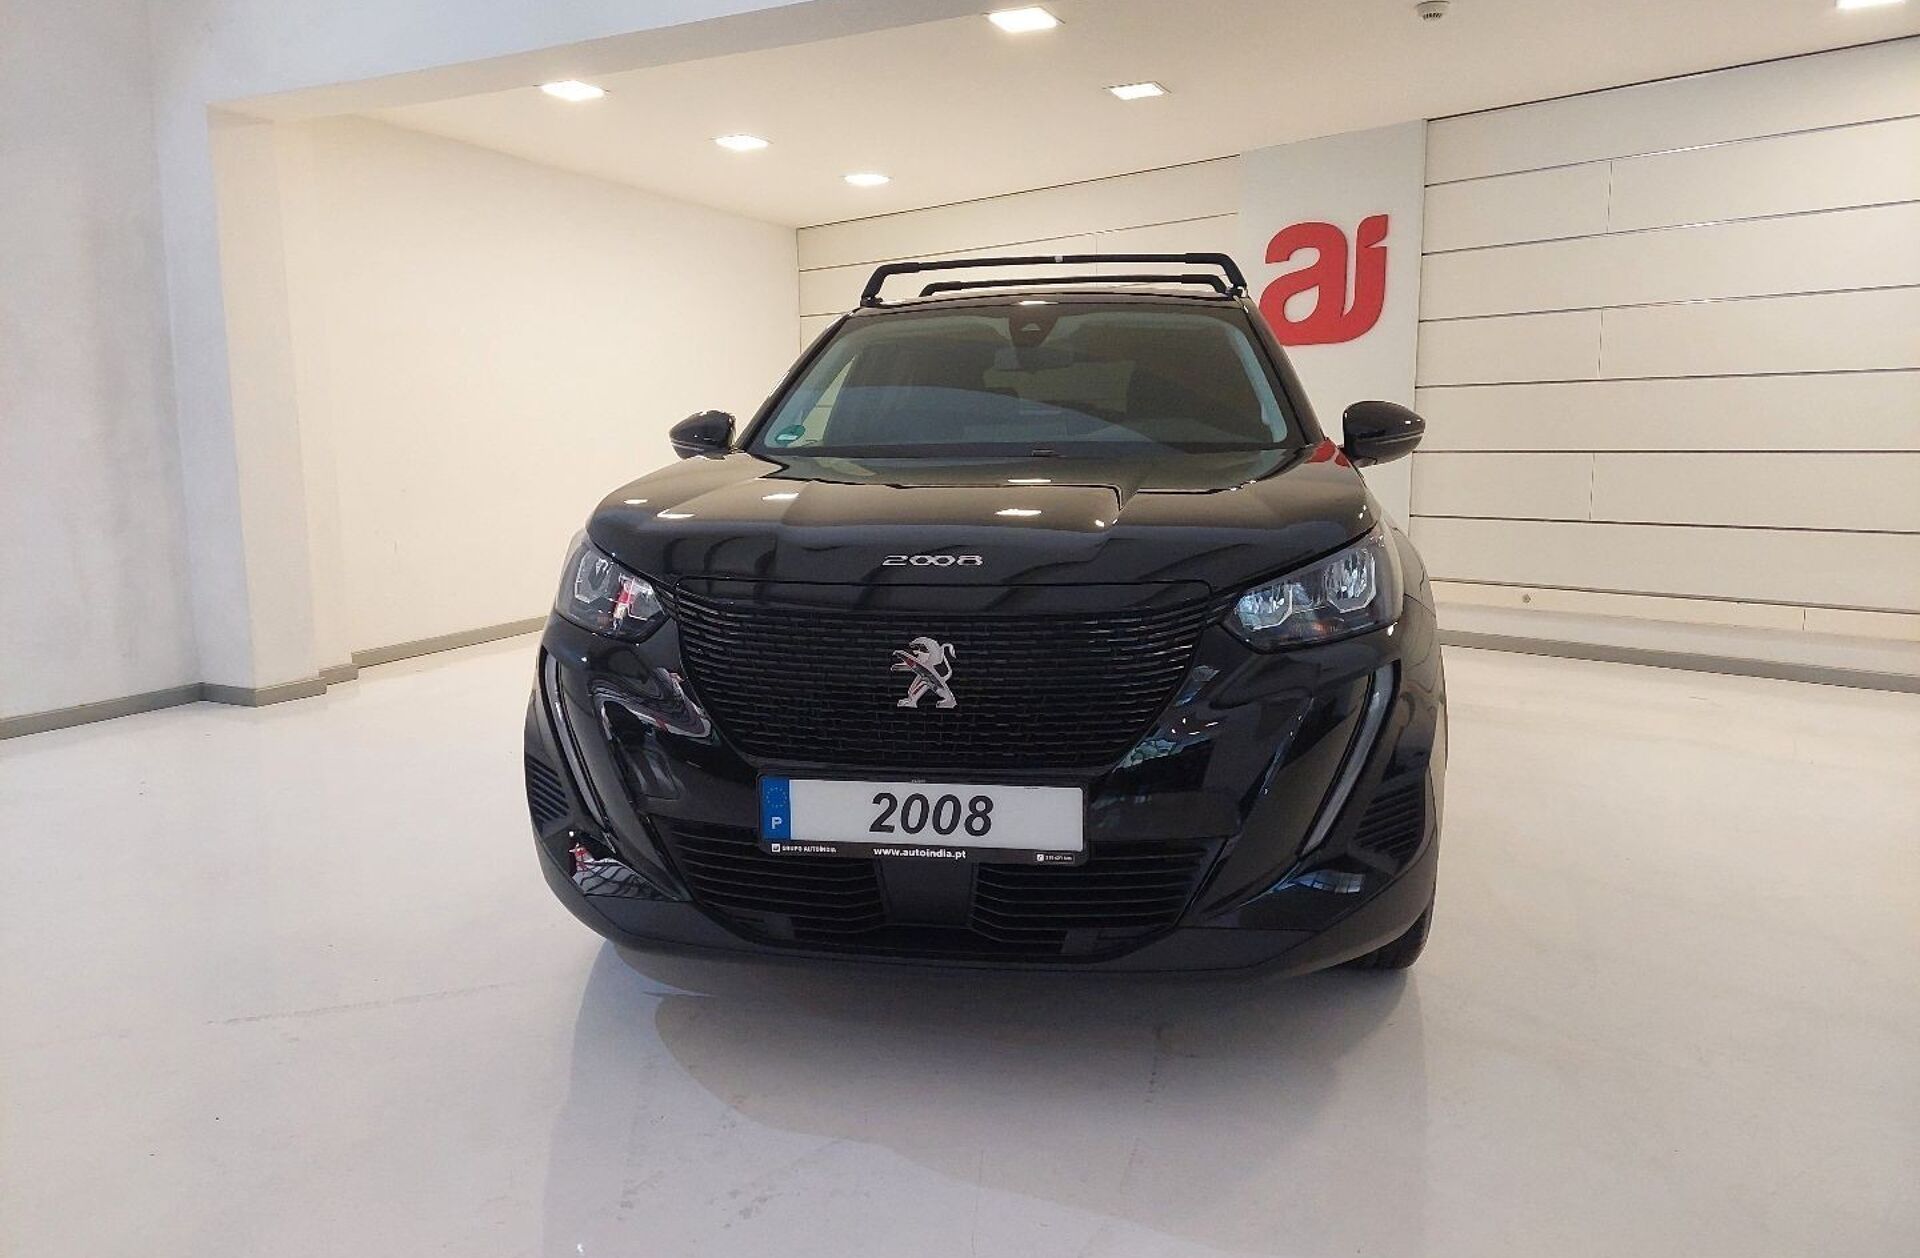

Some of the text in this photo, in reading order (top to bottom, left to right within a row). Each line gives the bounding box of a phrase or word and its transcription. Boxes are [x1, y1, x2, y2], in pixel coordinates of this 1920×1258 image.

[882, 555, 984, 567] 2008
[869, 792, 994, 837] 2008
[771, 816, 783, 830] P
[873, 847, 967, 859] www.autoindia.pt
